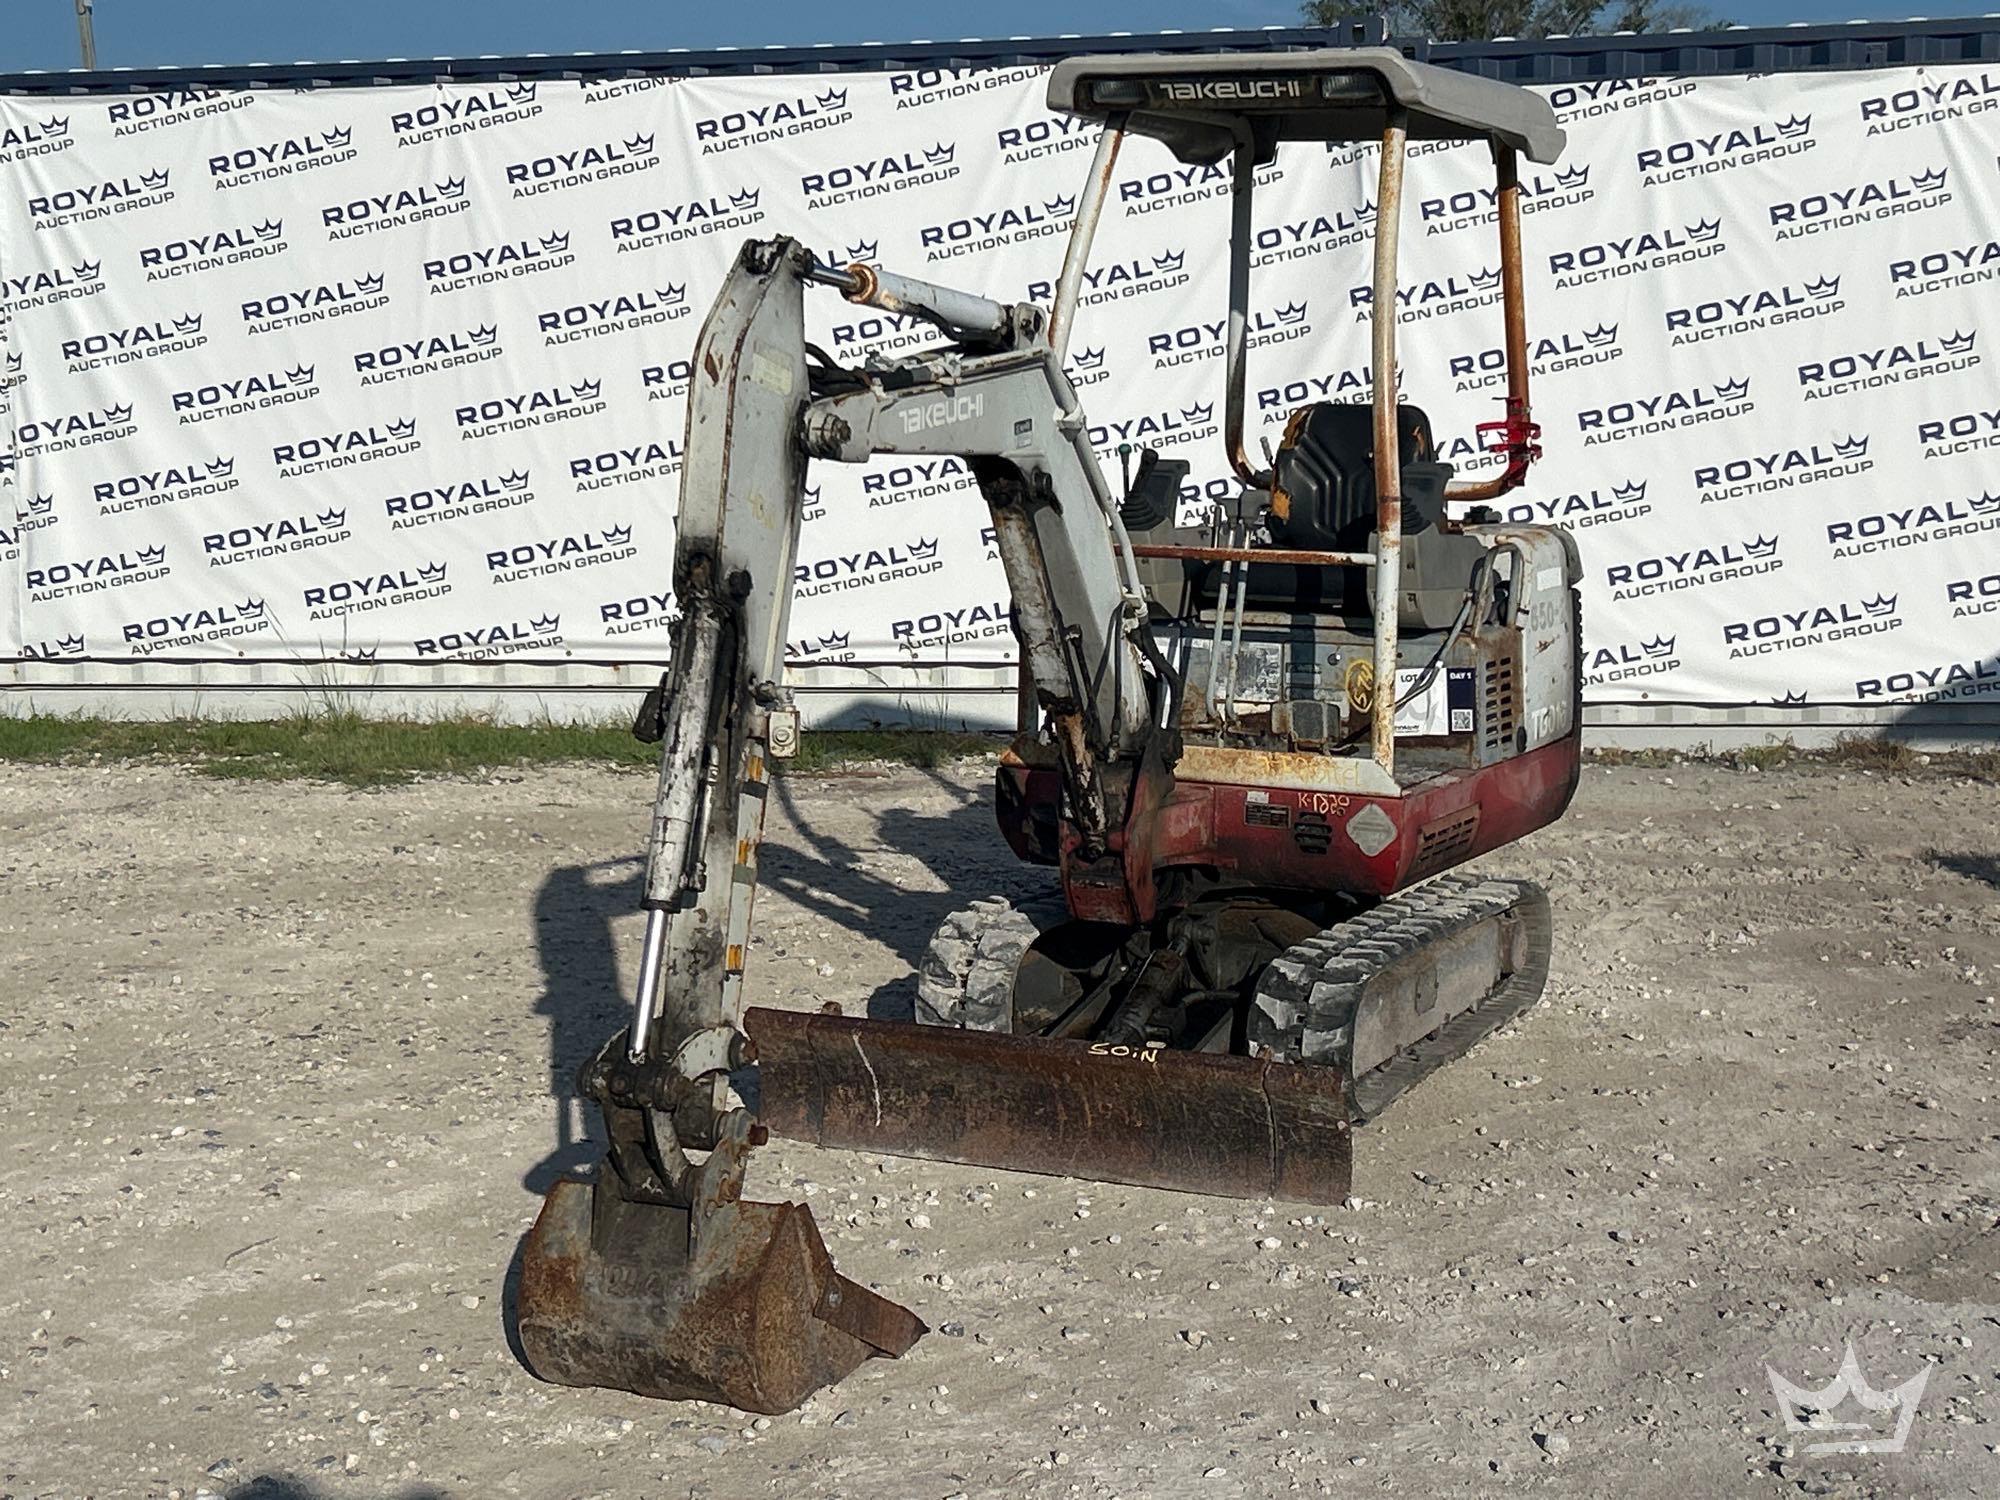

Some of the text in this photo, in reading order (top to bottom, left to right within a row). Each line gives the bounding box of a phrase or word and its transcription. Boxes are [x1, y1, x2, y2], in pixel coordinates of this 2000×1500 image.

[391, 92, 507, 133] ROYAL
[897, 82, 980, 110] AUCTION
[1624, 83, 1696, 108] GROUP
[115, 96, 254, 137] AUCTION GROUP
[399, 106, 542, 148] AUCTION GROUP
[696, 99, 817, 140] ROYAL
[703, 112, 852, 155] AUCTION GROUP
[1867, 107, 1963, 137] AUCTION
[16, 139, 74, 159] GROUP
[209, 136, 323, 176] ROYAL
[506, 144, 625, 184] ROYAL
[1004, 136, 1088, 165] AUCTION
[1637, 126, 1776, 172] ROYAL
[1643, 139, 1816, 187] AUCTION GROUP
[216, 149, 357, 190] AUCTION GROUP
[513, 157, 659, 199] AUCTION GROUP
[802, 154, 924, 195] ROYAL
[808, 167, 960, 210] AUCTION GROUP
[29, 179, 141, 216] ROYAL
[35, 192, 174, 231] AUCTION GROUP
[322, 187, 437, 226] ROYAL
[1126, 188, 1211, 217] AUCTION
[1522, 190, 1594, 214] GROUP
[1770, 180, 1911, 225] ROYAL
[329, 200, 470, 241] AUCTION GROUP
[611, 198, 730, 239] ROYAL
[618, 212, 764, 253] AUCTION GROUP
[921, 206, 1044, 247] ROYAL
[1776, 193, 1952, 241] AUCTION GROUP
[140, 229, 255, 268] ROYAL
[927, 235, 1010, 262] AUCTION
[1326, 228, 1376, 250] GROU
[1549, 230, 1686, 274] ROYAL
[147, 242, 287, 282] AUCTION GROUP
[424, 242, 540, 280] ROYAL
[431, 255, 574, 295] AUCTION GROUP
[1556, 244, 1725, 290] AUCTION GROUP
[48, 283, 105, 303] GROUP
[242, 283, 356, 320] ROYAL
[1122, 274, 1189, 297] GROUP
[1350, 277, 1468, 307] RYAL
[1896, 269, 1992, 299] AUCTION
[249, 296, 389, 335] AUCTION GROUP
[538, 293, 656, 332] ROYAL
[545, 307, 691, 346] AUCTION GROUP
[1666, 287, 1804, 331] ROYAL
[1672, 301, 1844, 346] AUCTION GROUP
[62, 323, 174, 360] ROYAL
[69, 336, 207, 374] AUCTION GROUP
[354, 334, 469, 372] ROYAL
[1450, 334, 1583, 377] ROAL
[1551, 348, 1622, 372] GROUP
[361, 348, 502, 386] AUCTION GROUP
[1798, 342, 1939, 385] ROYAL
[1805, 356, 1980, 401] AUCTION GROUP
[172, 374, 287, 411] ROYAL
[180, 387, 319, 425] AUCTION GROUP
[456, 389, 572, 426] ROYAL
[1578, 389, 1714, 431] ROYAL
[80, 426, 137, 445] GROUP
[462, 402, 606, 440] AUCTION GROUP
[1151, 426, 1218, 449] GROUP
[1584, 403, 1754, 446] AUCTION GROUP
[273, 428, 387, 465] ROYAL
[280, 441, 421, 478] AUCTION GROUP
[570, 440, 684, 478] ROYAL
[94, 466, 206, 501] ROYAL
[577, 468, 655, 492] AUCTION
[1695, 446, 1833, 488] ROYAL
[1701, 461, 1873, 504] AUCTION GROUP
[100, 479, 239, 516] AUCTION GROUP
[386, 479, 500, 516] ROYAL
[392, 493, 534, 530] AUCTION GROUP
[869, 483, 950, 508] AUCTION
[203, 517, 318, 553] ROYAL
[1580, 505, 1651, 527] GROUP
[1827, 502, 1968, 544] ROYAL
[211, 531, 351, 567] AUCTION GROUP
[487, 534, 603, 570] ROYAL
[1834, 532, 1928, 559] AUCTION
[27, 554, 138, 589] ROYAL
[32, 567, 170, 602] AUCTION GROUP
[493, 548, 637, 584] AUCTION GROUP
[794, 547, 908, 584] ROYAL
[795, 561, 942, 599] AUCTION GROUP
[1607, 545, 1743, 586] ROYAL
[1613, 560, 1783, 601] AUCTION GROUP
[304, 571, 418, 607] ROYAL
[310, 585, 451, 620] AUCTION GROUP
[123, 607, 236, 642] ROYAL
[132, 621, 269, 655] AUCTION GROUP
[414, 623, 530, 656] ROYAL
[1724, 604, 1862, 644] ROYAL
[1730, 619, 1902, 659] AUCTION GROUP
[503, 636, 563, 655] GROUP
[1609, 660, 1680, 681] GROUP
[1856, 660, 1997, 699] ROYAL
